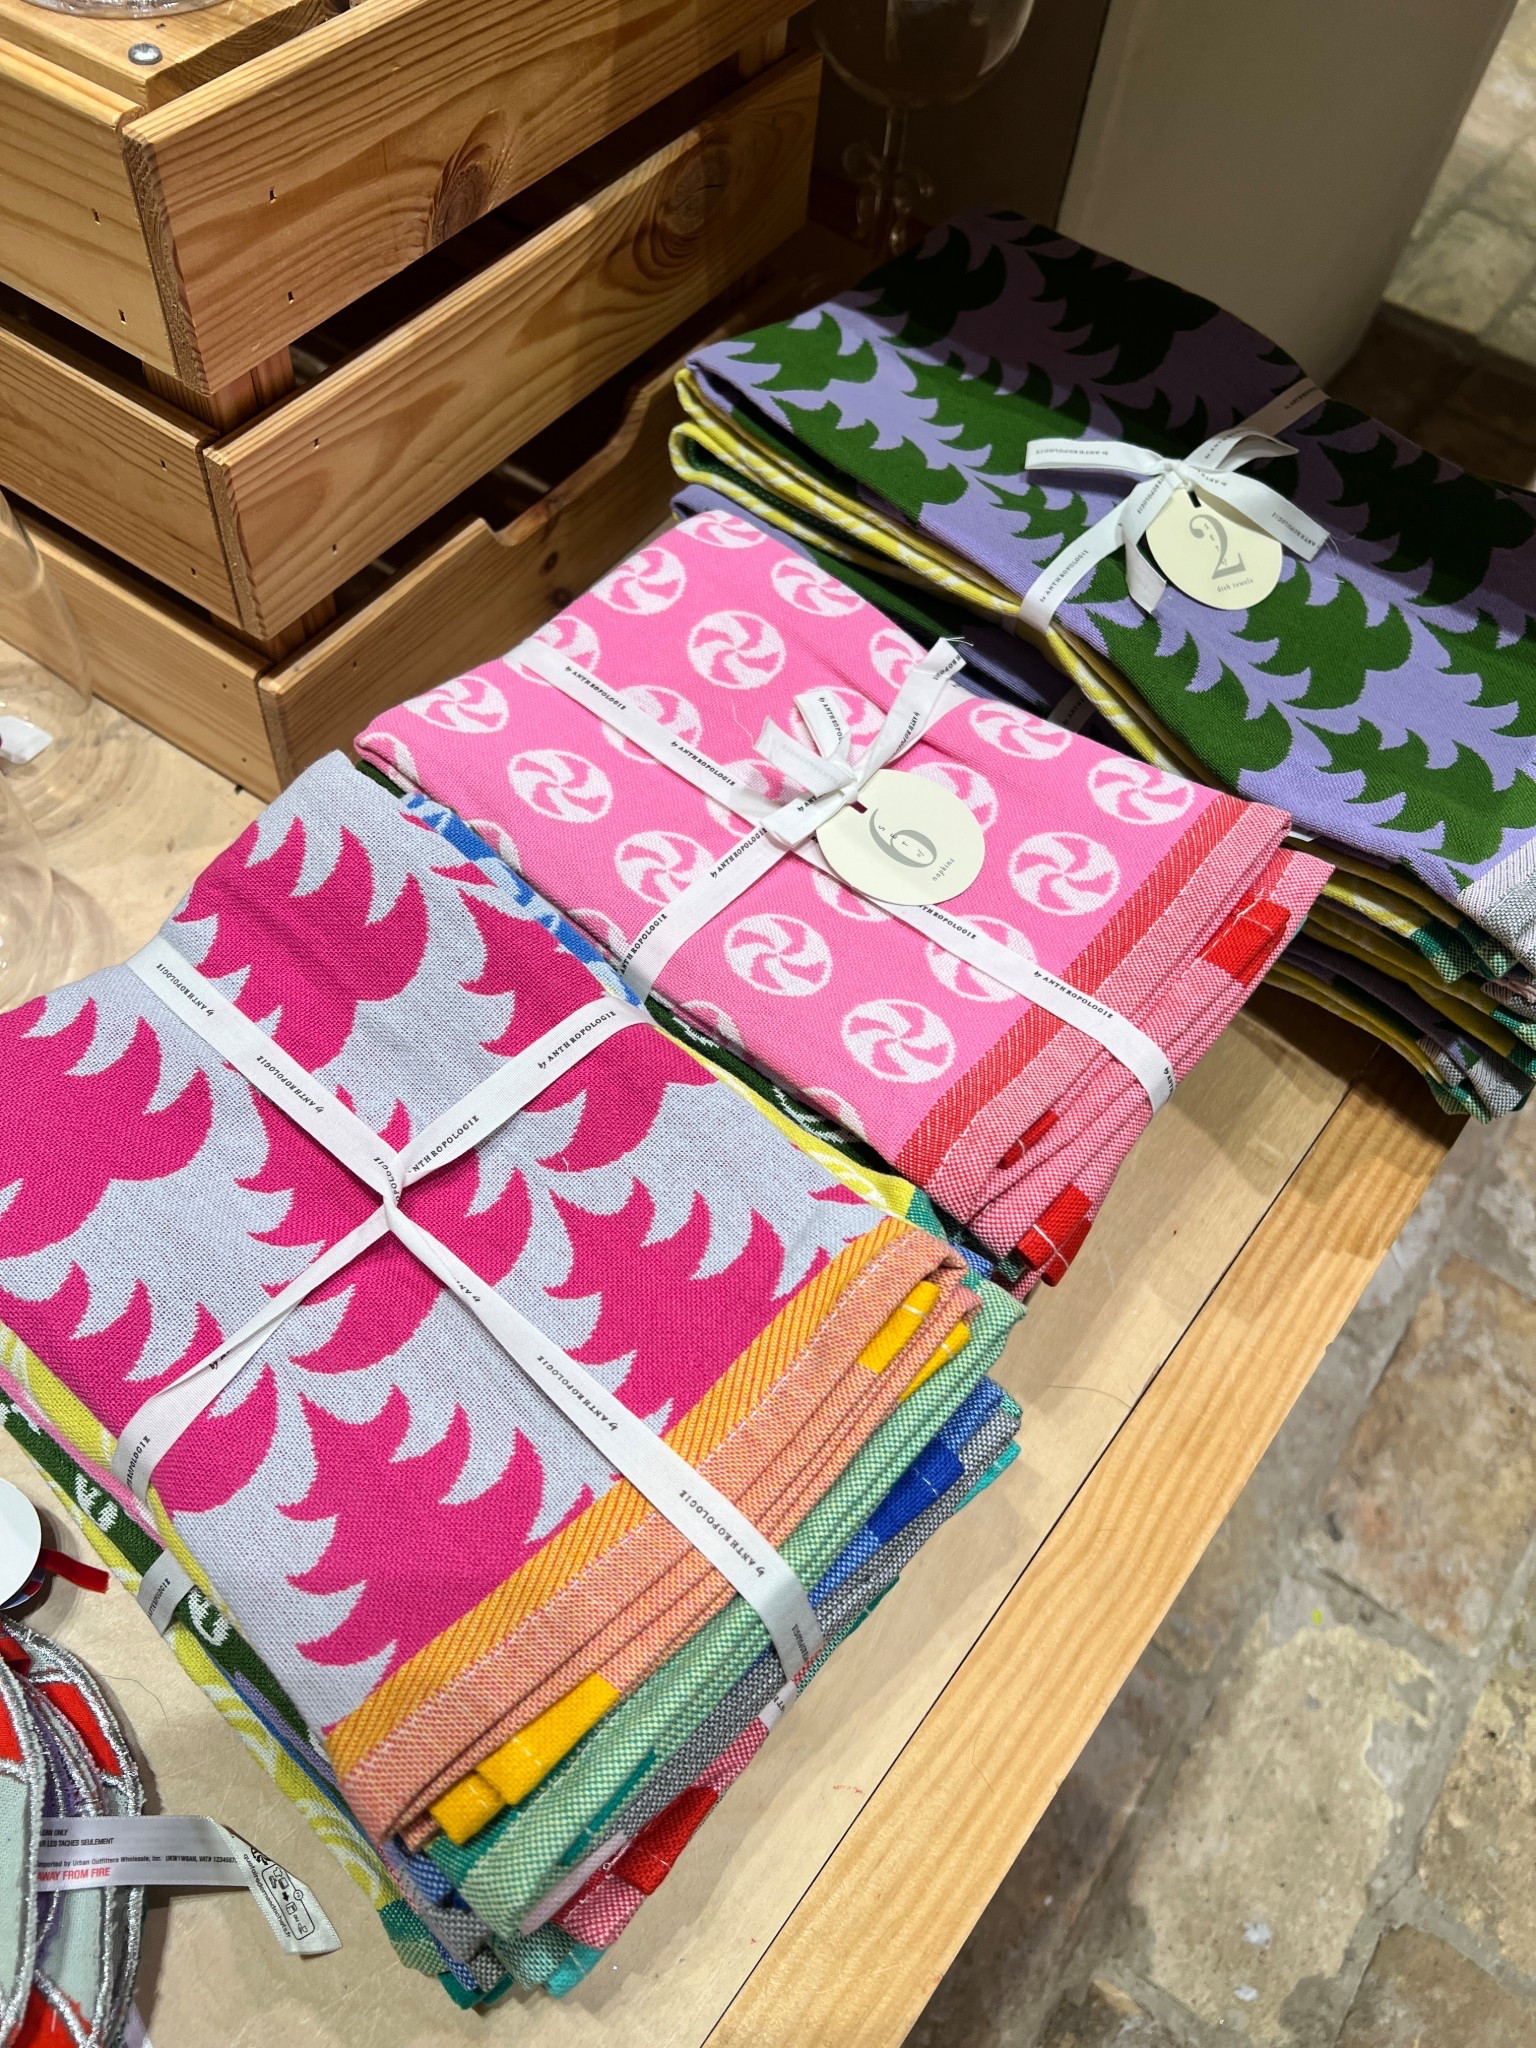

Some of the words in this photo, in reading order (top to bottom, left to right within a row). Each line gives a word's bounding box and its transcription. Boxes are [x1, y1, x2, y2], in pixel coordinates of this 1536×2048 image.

[1189, 514, 1246, 580] 2
[1045, 549, 1089, 595] ANTHROPOLOGIE
[1217, 584, 1232, 593] dish
[1232, 577, 1254, 590] towels
[571, 671, 627, 711] ANTHROPOLOGIE
[671, 740, 679, 749] by
[678, 746, 736, 787] ANTHROPOLOGIE
[710, 870, 718, 878] by
[717, 828, 768, 873] ANTHROPOLOGIE
[869, 808, 938, 868] 6
[932, 858, 955, 881] napkins
[619, 913, 668, 975] ANTHROPOLOGIE
[156, 963, 208, 1011] ANTHROPOLOGIE
[1034, 970, 1042, 978] by
[1042, 975, 1114, 1020] ANTHROPOLOGIE
[537, 1060, 547, 1070] by
[547, 1010, 617, 1062] ANTHROPOLOGIE
[256, 1055, 317, 1107] ANTHROPOLOGIE
[315, 1105, 325, 1114] by
[407, 1115, 480, 1174] NTHROPOLOGIE
[536, 1355, 609, 1422] ANTHROPOLOGIE
[608, 1421, 619, 1431] by
[679, 1489, 756, 1567] ANTHROPOLOGIE
[756, 1565, 766, 1578] by
[59, 1839, 80, 1847] TACHES
[81, 1837, 115, 1846] SEULEMENT
[92, 1857, 119, 1865] Outfitters
[63, 1868, 89, 1881] FROM
[91, 1867, 111, 1878] FIRE
